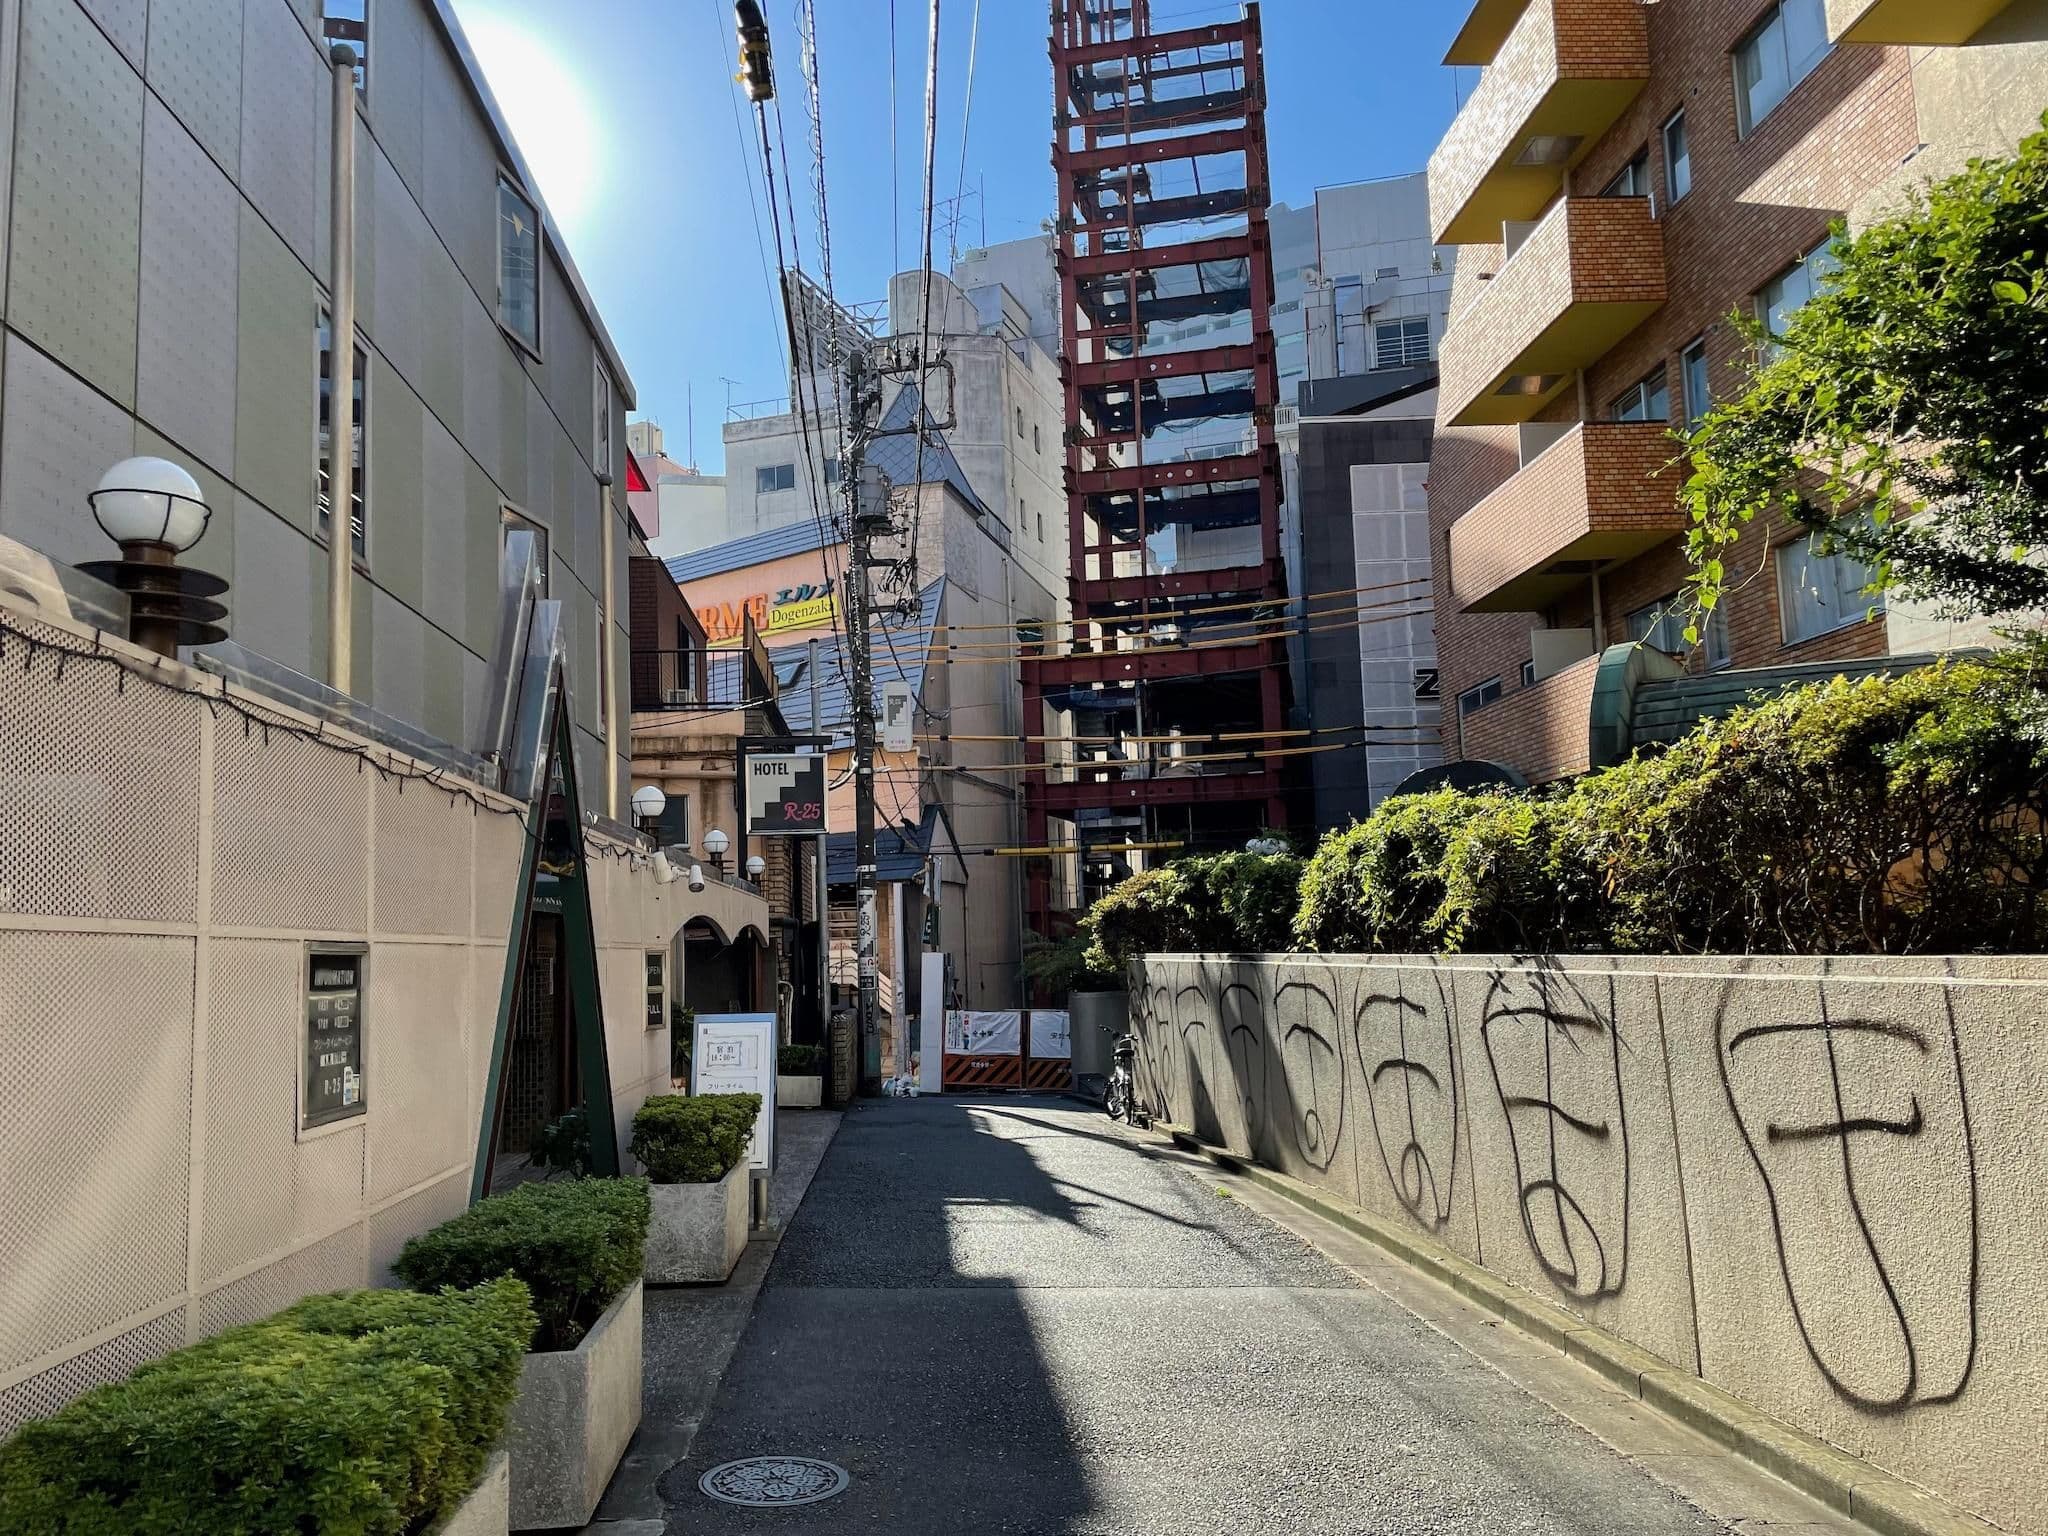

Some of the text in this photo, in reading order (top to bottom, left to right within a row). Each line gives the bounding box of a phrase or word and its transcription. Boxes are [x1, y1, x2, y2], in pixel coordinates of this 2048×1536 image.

[773, 577, 835, 605] エルメ
[754, 763, 789, 775] HOTEL
[784, 802, 821, 821] R-25
